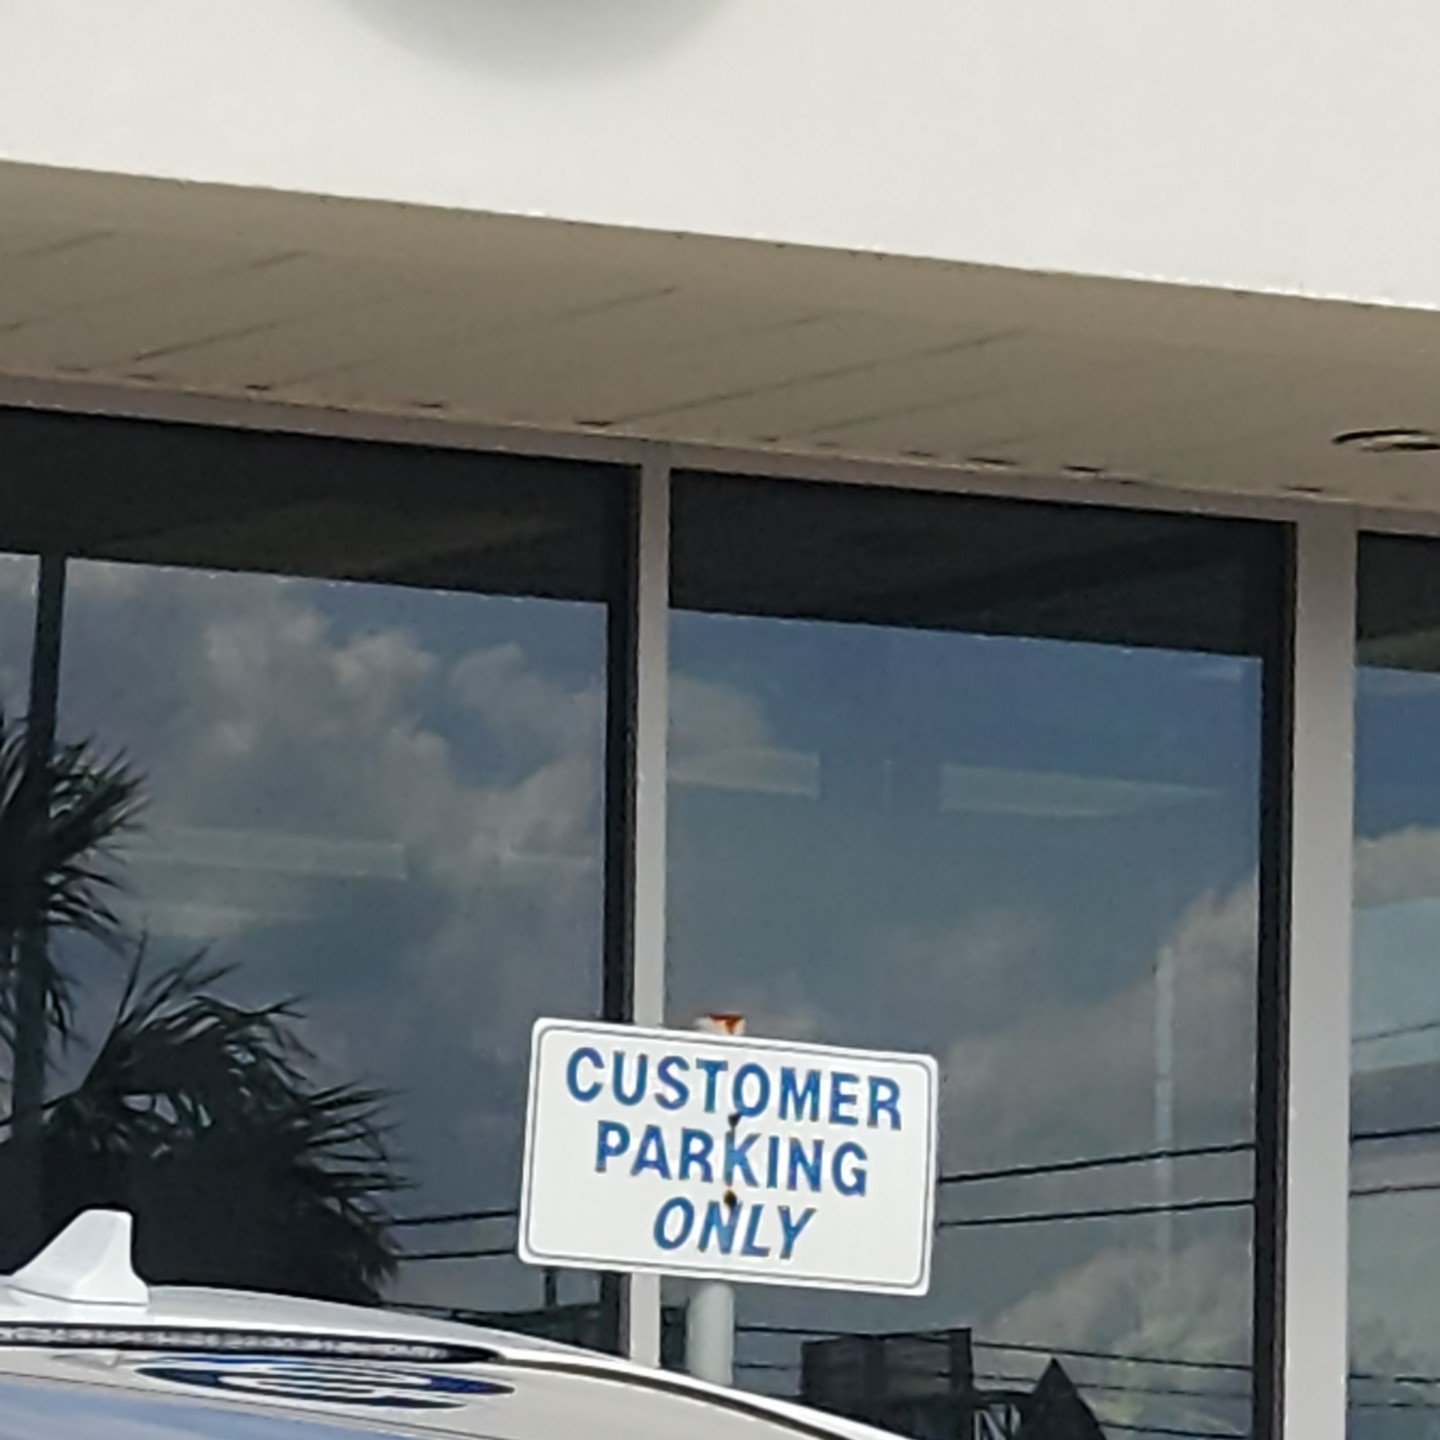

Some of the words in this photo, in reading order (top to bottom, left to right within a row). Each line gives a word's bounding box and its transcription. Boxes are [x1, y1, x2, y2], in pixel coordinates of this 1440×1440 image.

[566, 1046, 902, 1131] CUSTOMER
[594, 1119, 868, 1196] PARKING
[653, 1196, 817, 1261] ONLY
